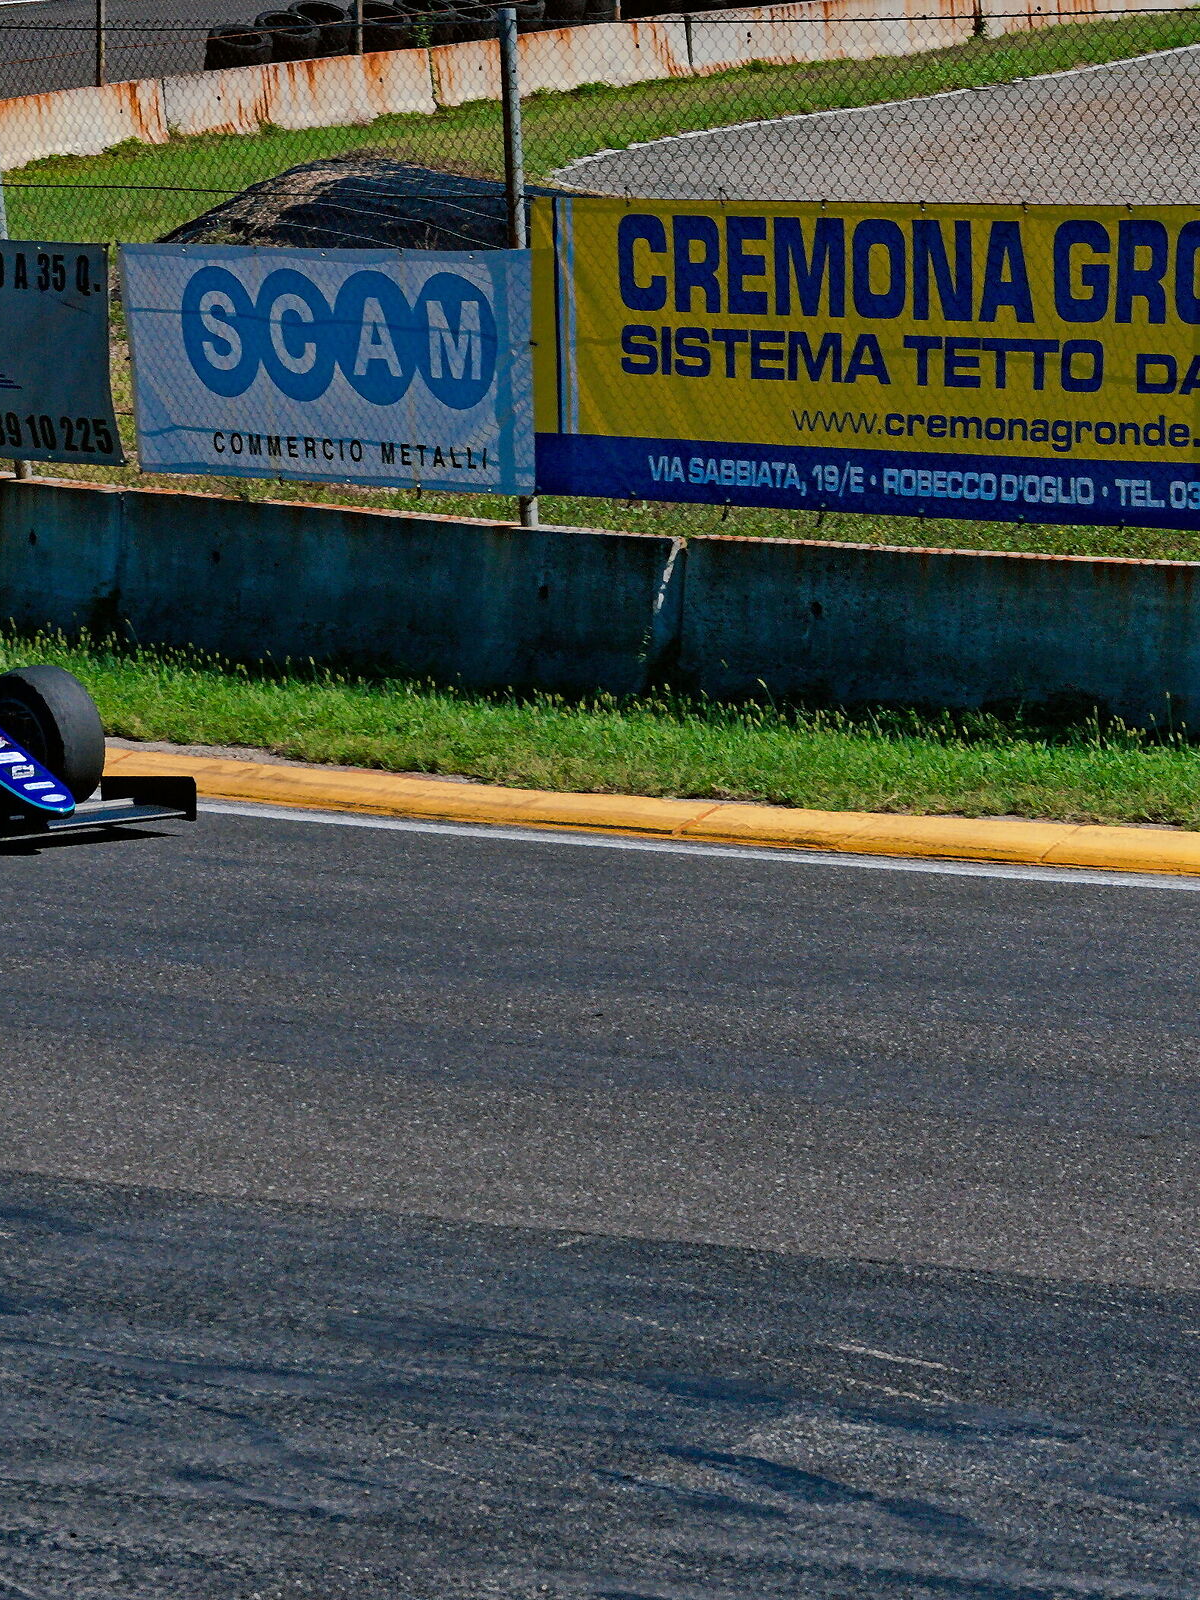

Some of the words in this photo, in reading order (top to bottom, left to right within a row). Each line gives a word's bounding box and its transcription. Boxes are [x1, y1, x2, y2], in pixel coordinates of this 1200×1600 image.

[14, 252, 28, 290] A
[37, 253, 66, 292] 35
[75, 254, 101, 296] Q.
[617, 213, 1035, 324] CREMONA
[200, 291, 483, 381] SCAM
[620, 324, 892, 385] SISTEMA
[903, 334, 1104, 393] TETTO
[25, 413, 57, 451] 10
[60, 417, 114, 454] 225
[213, 431, 363, 463] COMMERCIO
[381, 441, 488, 470] METALLI
[648, 455, 684, 483] VIA
[688, 457, 807, 497] SABBIATA,
[811, 461, 864, 497] 19/E
[883, 467, 997, 501] ROBECCO
[1001, 473, 1095, 504] D'OGLIO
[1115, 478, 1165, 508] TEL.
